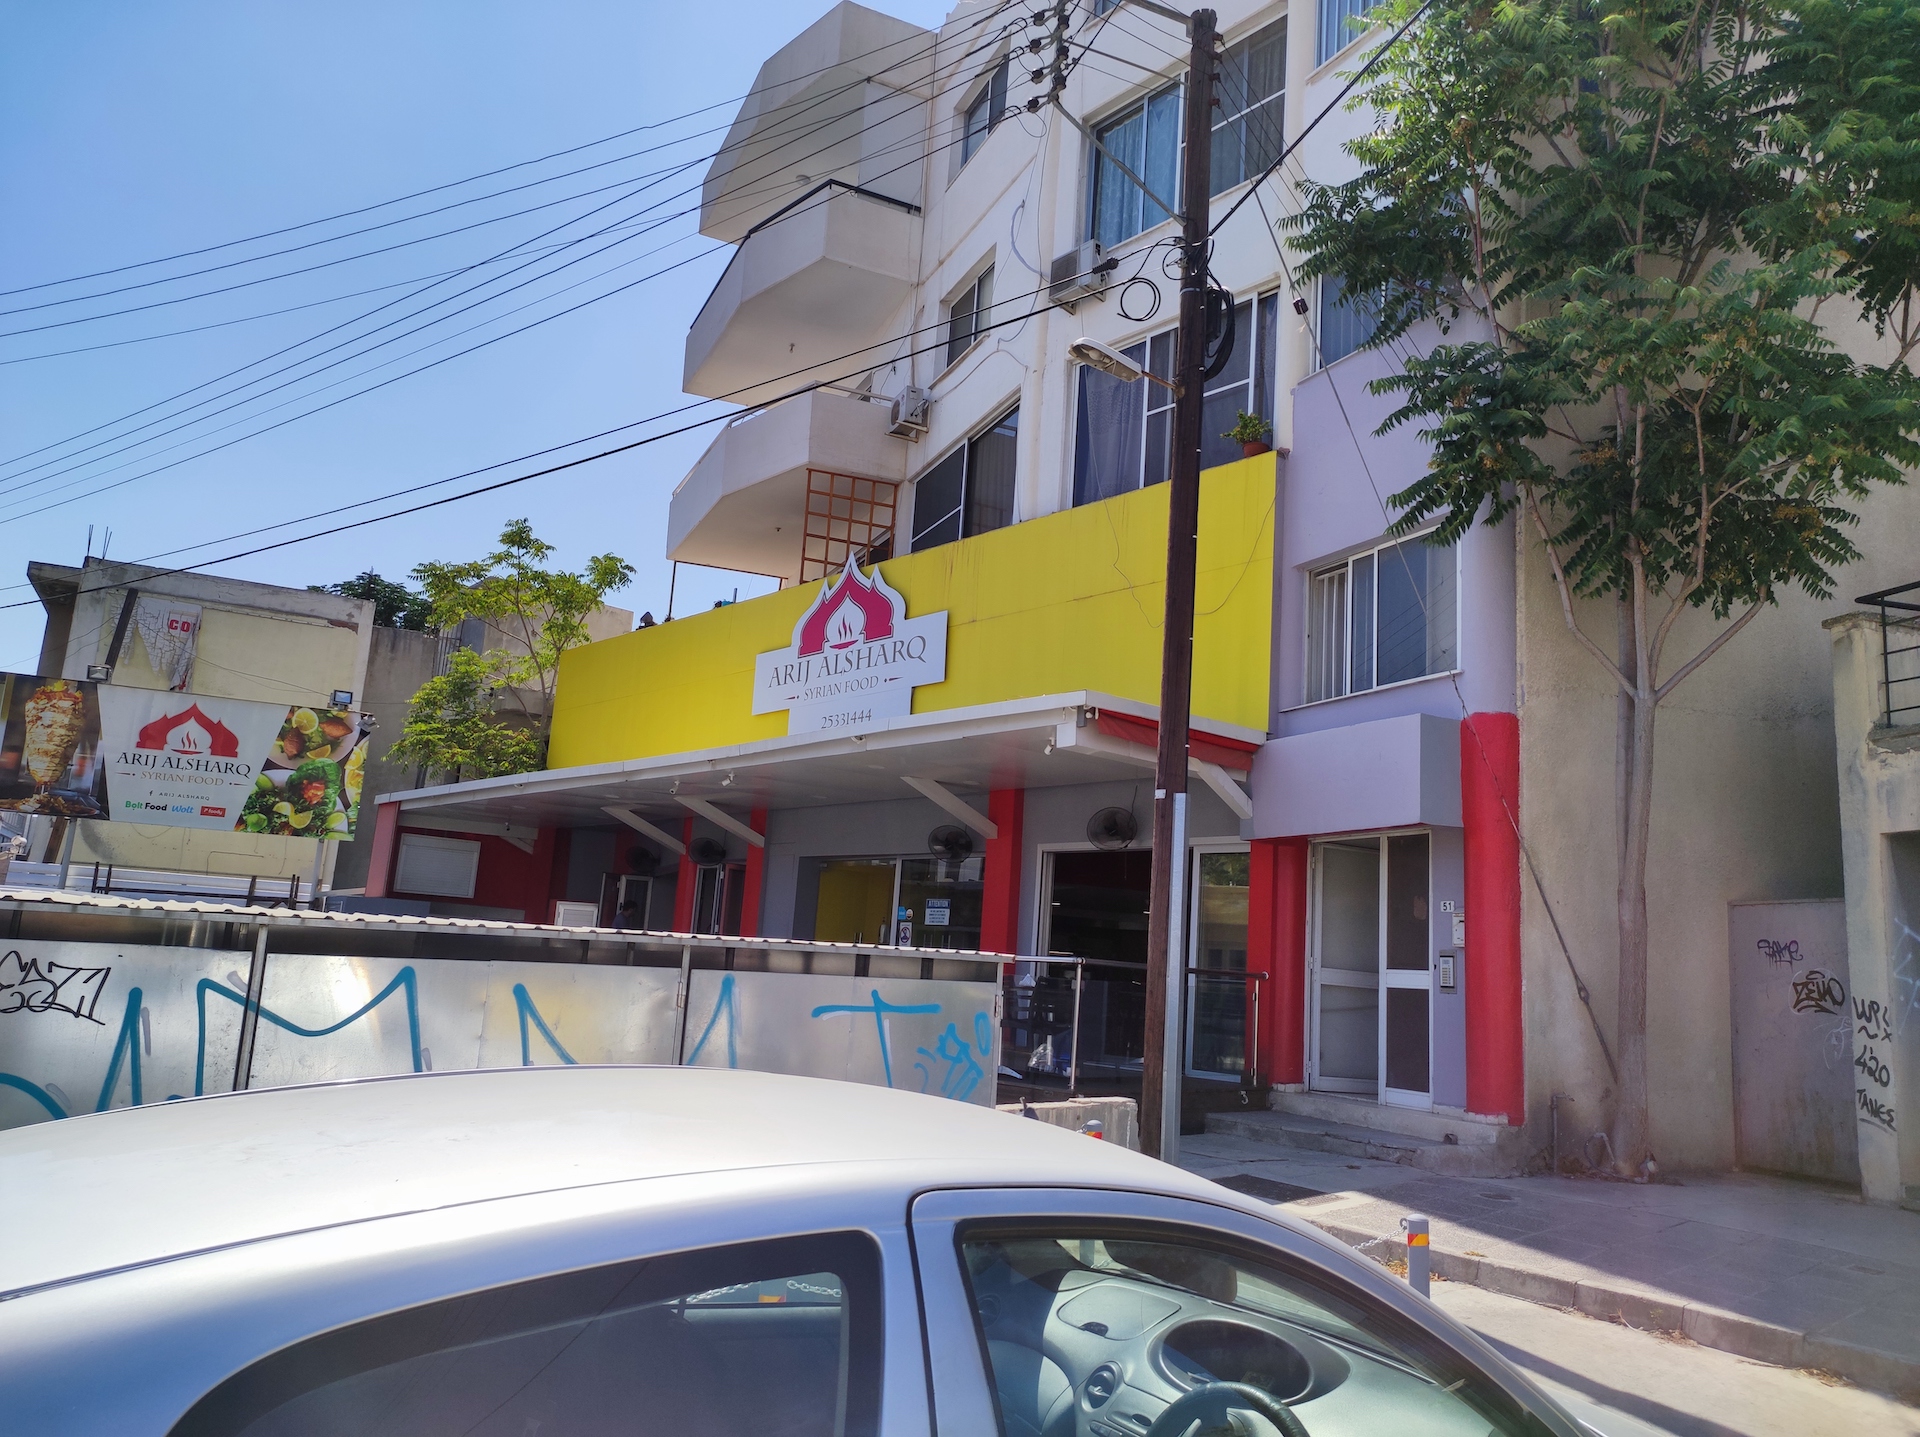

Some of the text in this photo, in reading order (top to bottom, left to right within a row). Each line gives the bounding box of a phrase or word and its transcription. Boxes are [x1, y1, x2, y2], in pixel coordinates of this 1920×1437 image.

[768, 635, 927, 688] ARIJ ALSHARQ
[803, 675, 879, 701] SYRIAN FOOD
[821, 708, 872, 729] 25331444
[116, 751, 251, 780] ARIJ ALSHARQ
[140, 771, 224, 787] SYRIAN FOOD
[125, 800, 143, 811] Bolt
[144, 802, 168, 812] Food
[171, 805, 194, 814] Wolt
[177, 794, 211, 802] ALSHARQ
[1443, 902, 1452, 911] 51
